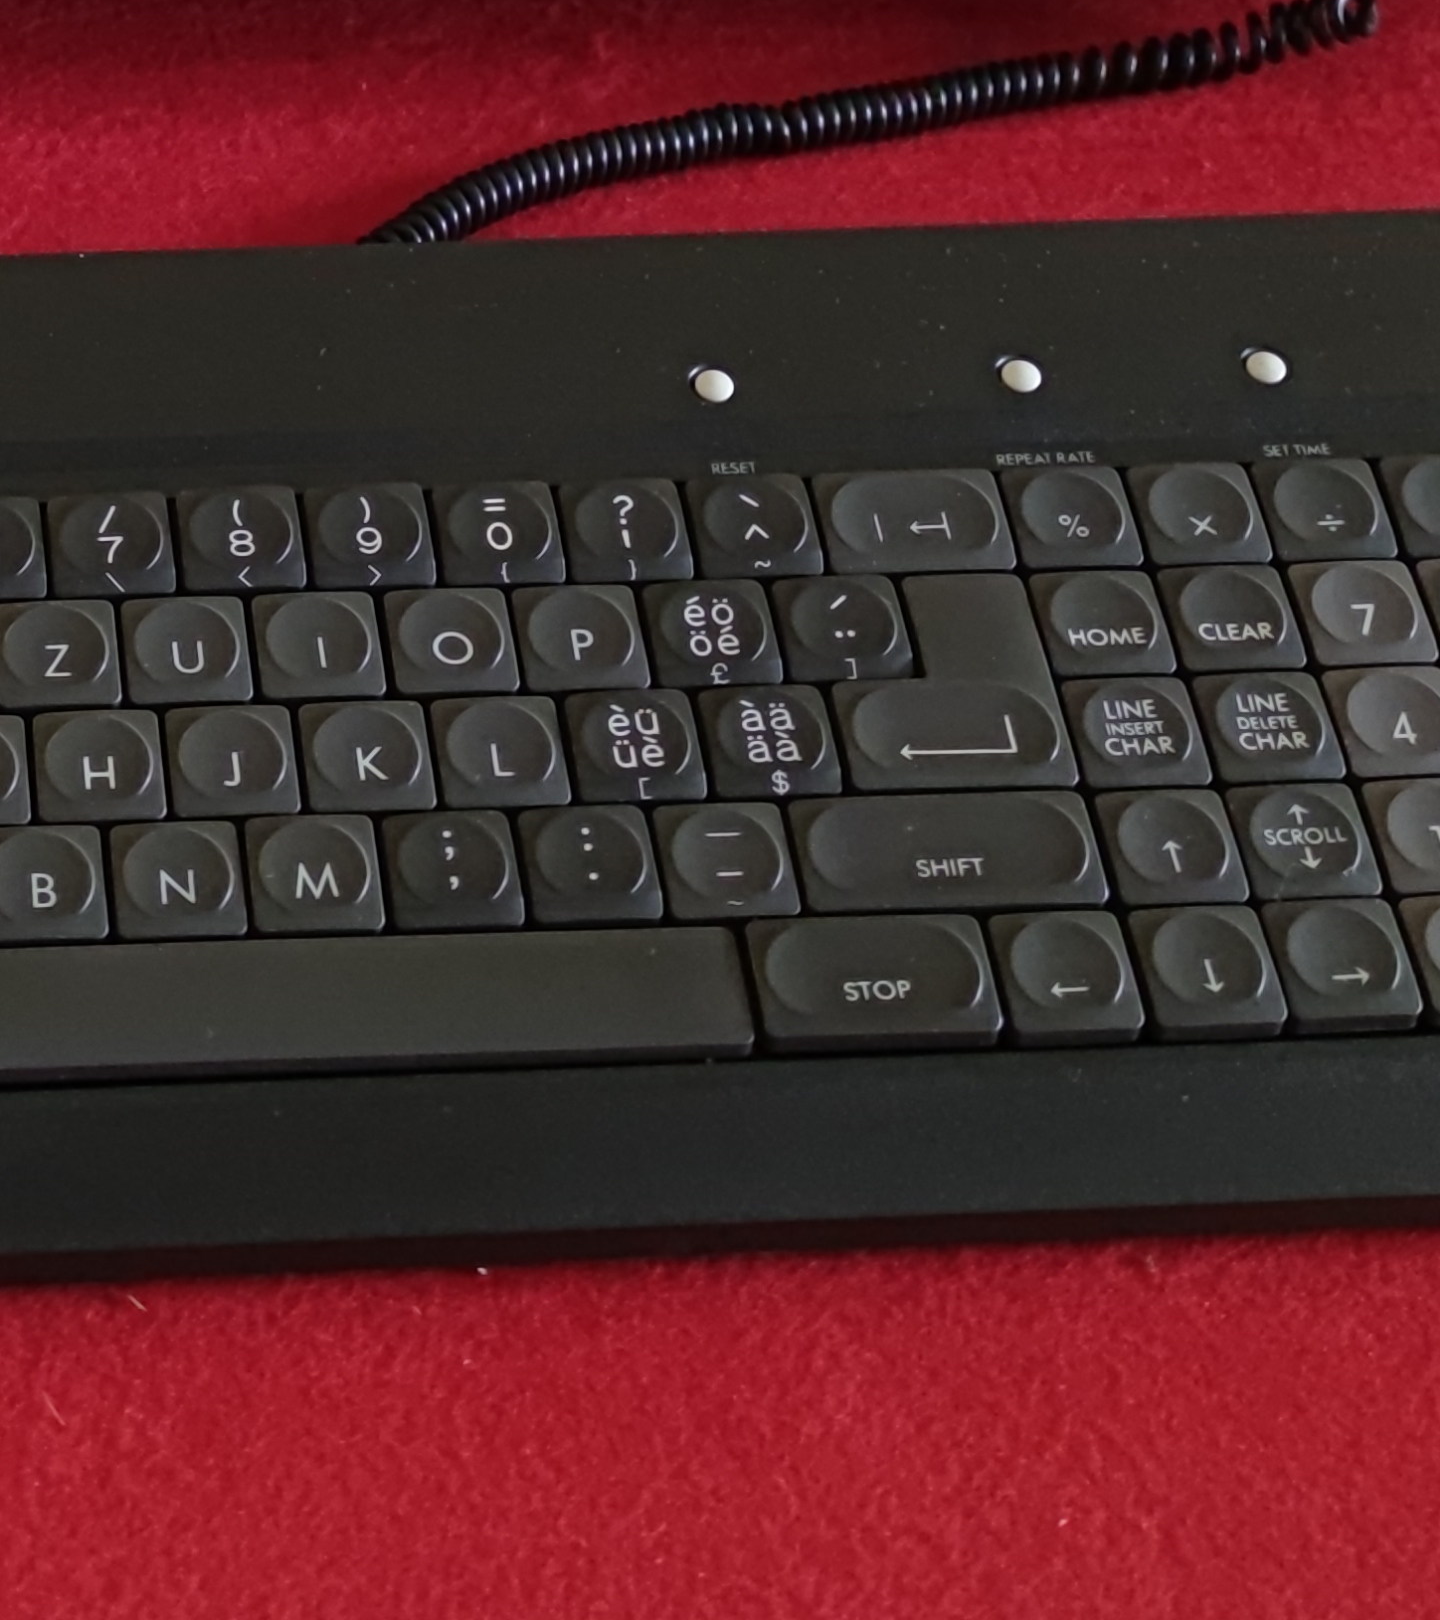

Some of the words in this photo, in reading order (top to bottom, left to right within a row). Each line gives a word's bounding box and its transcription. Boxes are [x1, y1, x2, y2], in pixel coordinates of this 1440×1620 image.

[995, 452, 1051, 466] REPEAT
[1055, 451, 1094, 463] RATE
[1262, 444, 1289, 457] SET
[1293, 443, 1330, 455] TIME
[710, 461, 755, 475] RESET
[1067, 627, 1146, 647] HOME
[1197, 622, 1273, 642] CLEAR
[432, 631, 474, 665] O
[570, 628, 594, 661] P
[44, 643, 72, 678] Z
[171, 640, 205, 674] U
[1102, 699, 1156, 720] LINE
[1235, 693, 1289, 713] LINE
[1105, 720, 1163, 736] INSERT
[1235, 715, 1296, 730] DELETE
[1104, 736, 1174, 757] CHAR
[1238, 731, 1309, 751] CHAR
[223, 751, 241, 787] J
[355, 746, 387, 781] K
[490, 743, 515, 777] L
[82, 756, 116, 790] H
[1263, 826, 1347, 847] SCROLL
[915, 857, 983, 878] SHIFT
[30, 872, 57, 908] B
[159, 869, 196, 905] N
[295, 863, 339, 899] M
[843, 979, 911, 1002] STOP
